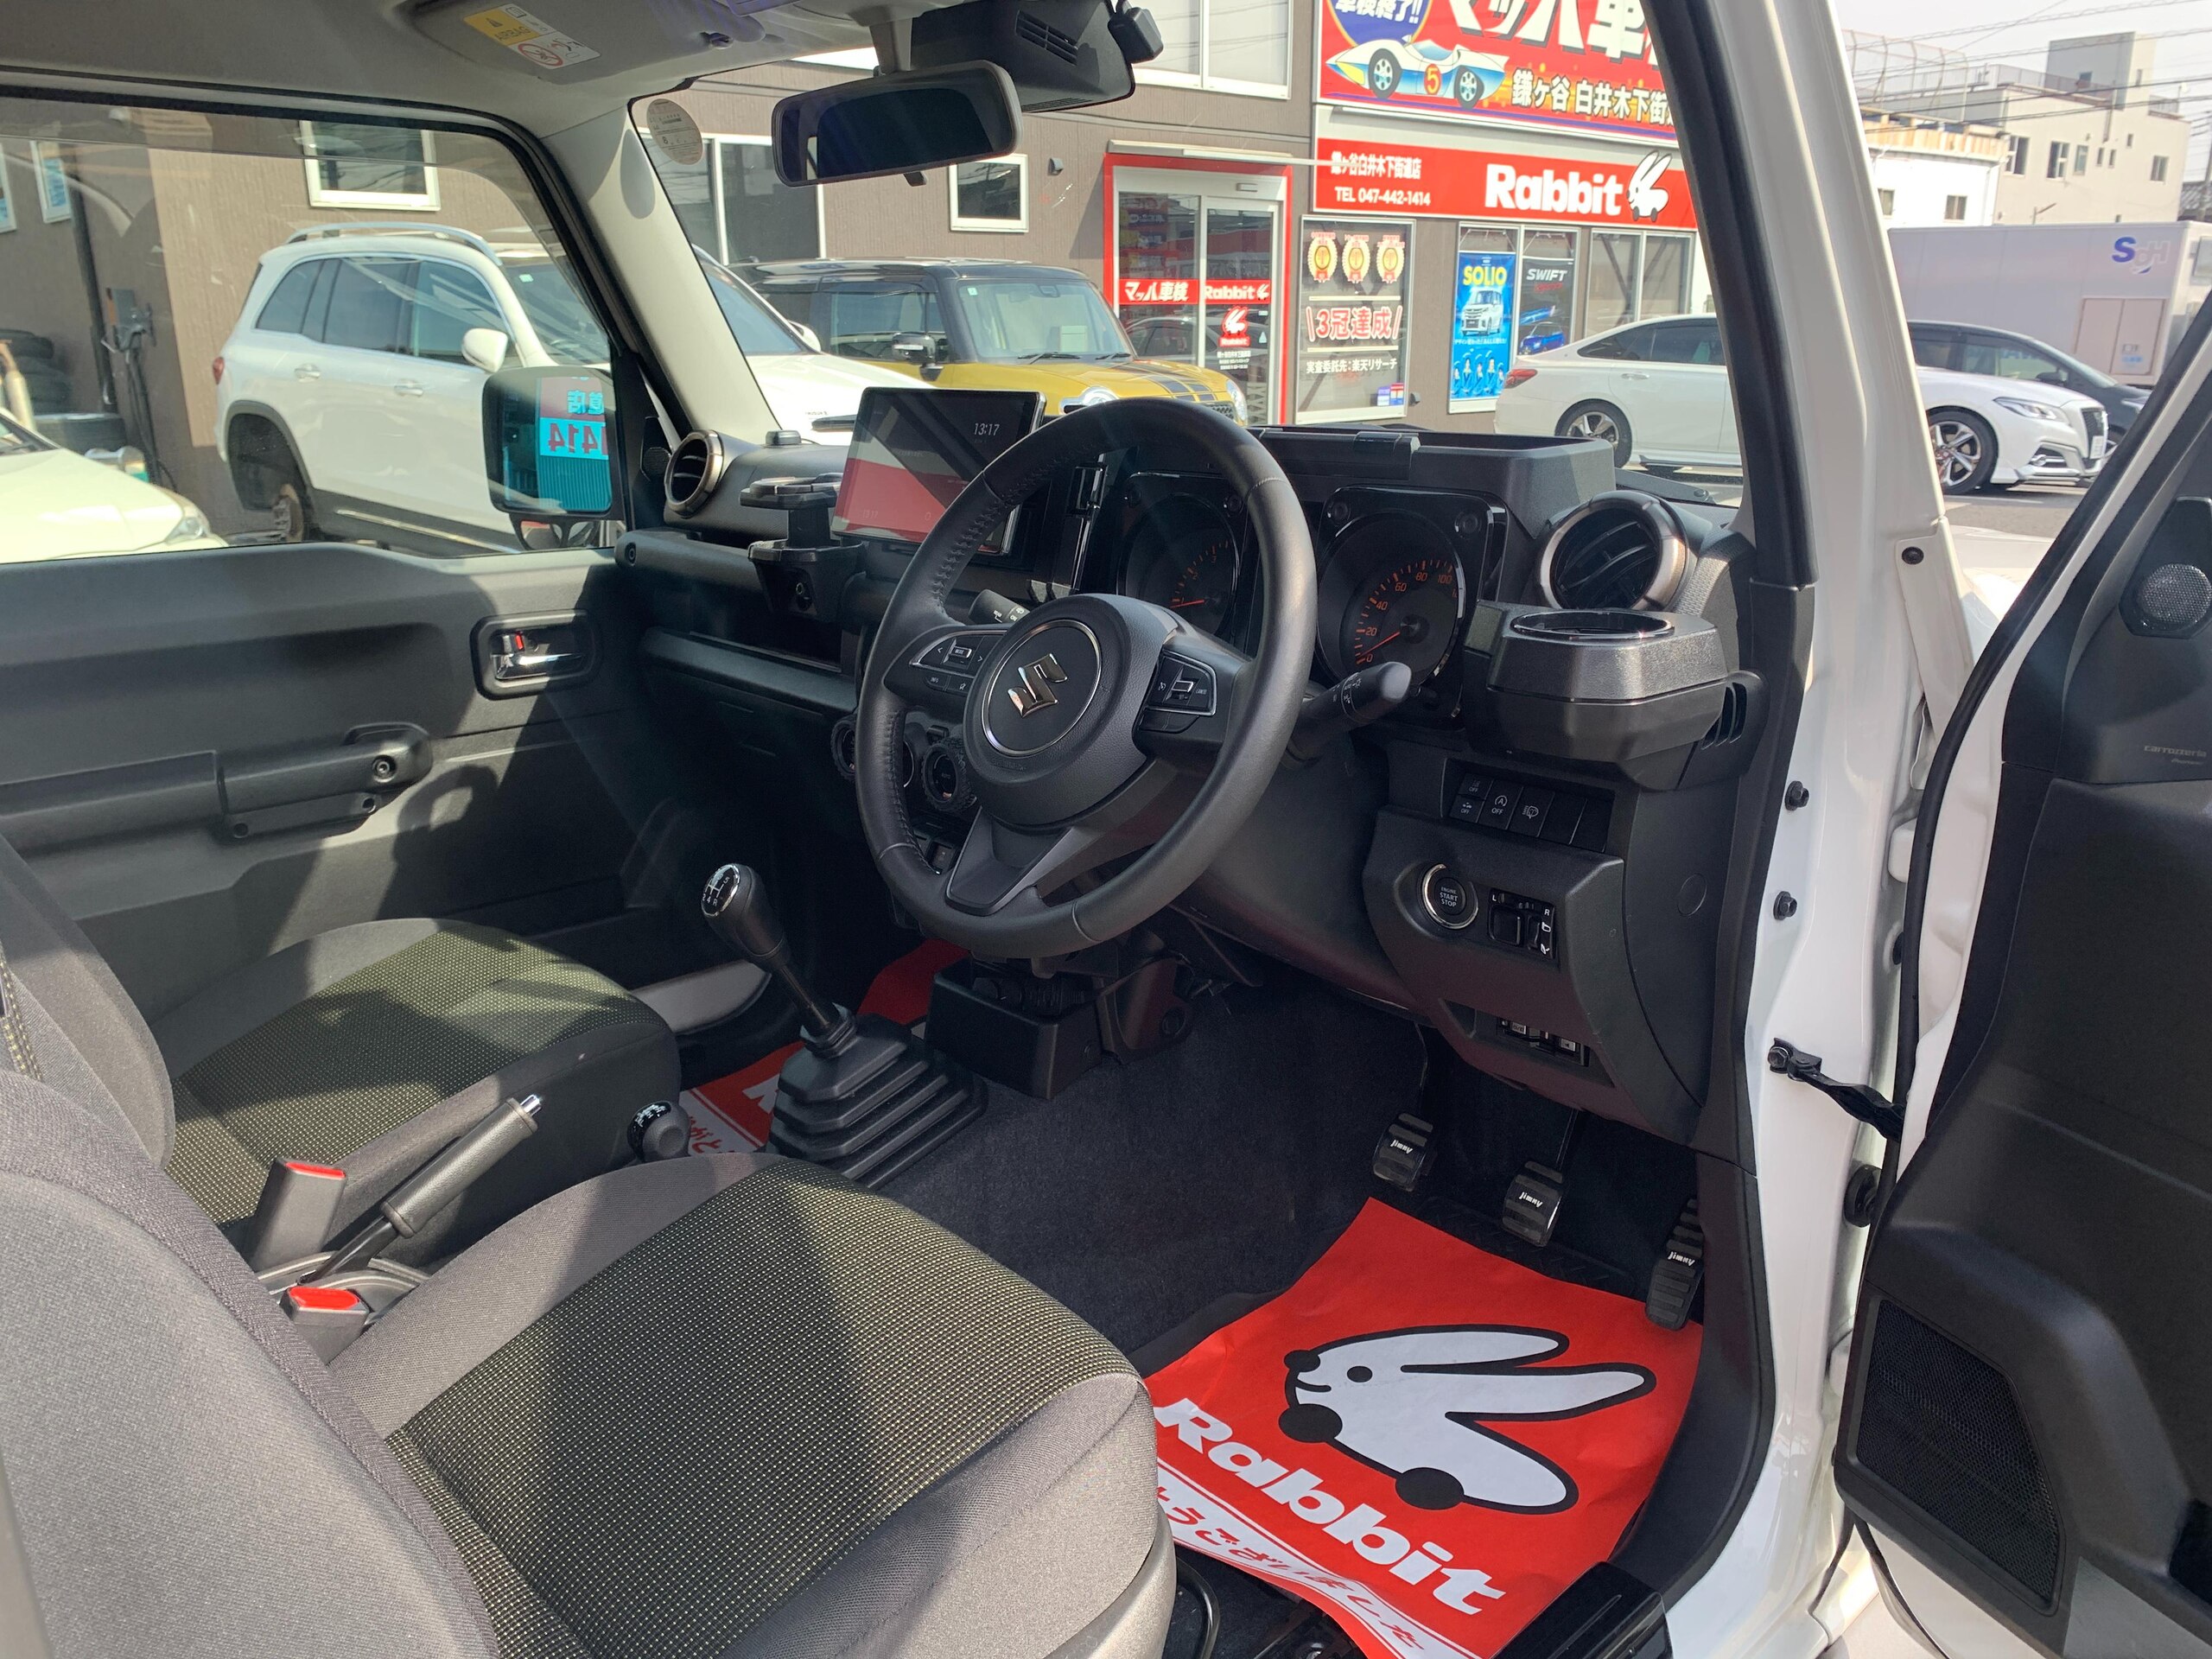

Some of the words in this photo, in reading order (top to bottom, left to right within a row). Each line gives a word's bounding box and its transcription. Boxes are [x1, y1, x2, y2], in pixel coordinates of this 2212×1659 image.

[1427, 67, 1439, 94] 5
[1574, 78, 1673, 127] 白井木下街
[1334, 186, 1357, 203] TEL
[1358, 187, 1431, 206] 047-442-1414
[1484, 163, 1623, 217] Rabbit
[1463, 266, 1507, 286] SOLIO
[1526, 269, 1567, 282] SWIFT
[1205, 285, 1255, 300] Rabbit
[1316, 307, 1392, 340] 3冠達成
[974, 423, 1000, 435] 13:17
[1415, 571, 1428, 582] 80
[1438, 575, 1452, 584] 100
[1395, 582, 1408, 592] 60
[1376, 601, 1388, 611] 40
[1365, 626, 1377, 637] 20
[1366, 653, 1374, 664] 0
[1440, 892, 1459, 901] START
[1440, 899, 1457, 907] STOP
[1519, 1191, 1543, 1208] Jimny
[1668, 1250, 1695, 1267] Jimny
[1154, 1397, 1506, 1616] Rabbit
